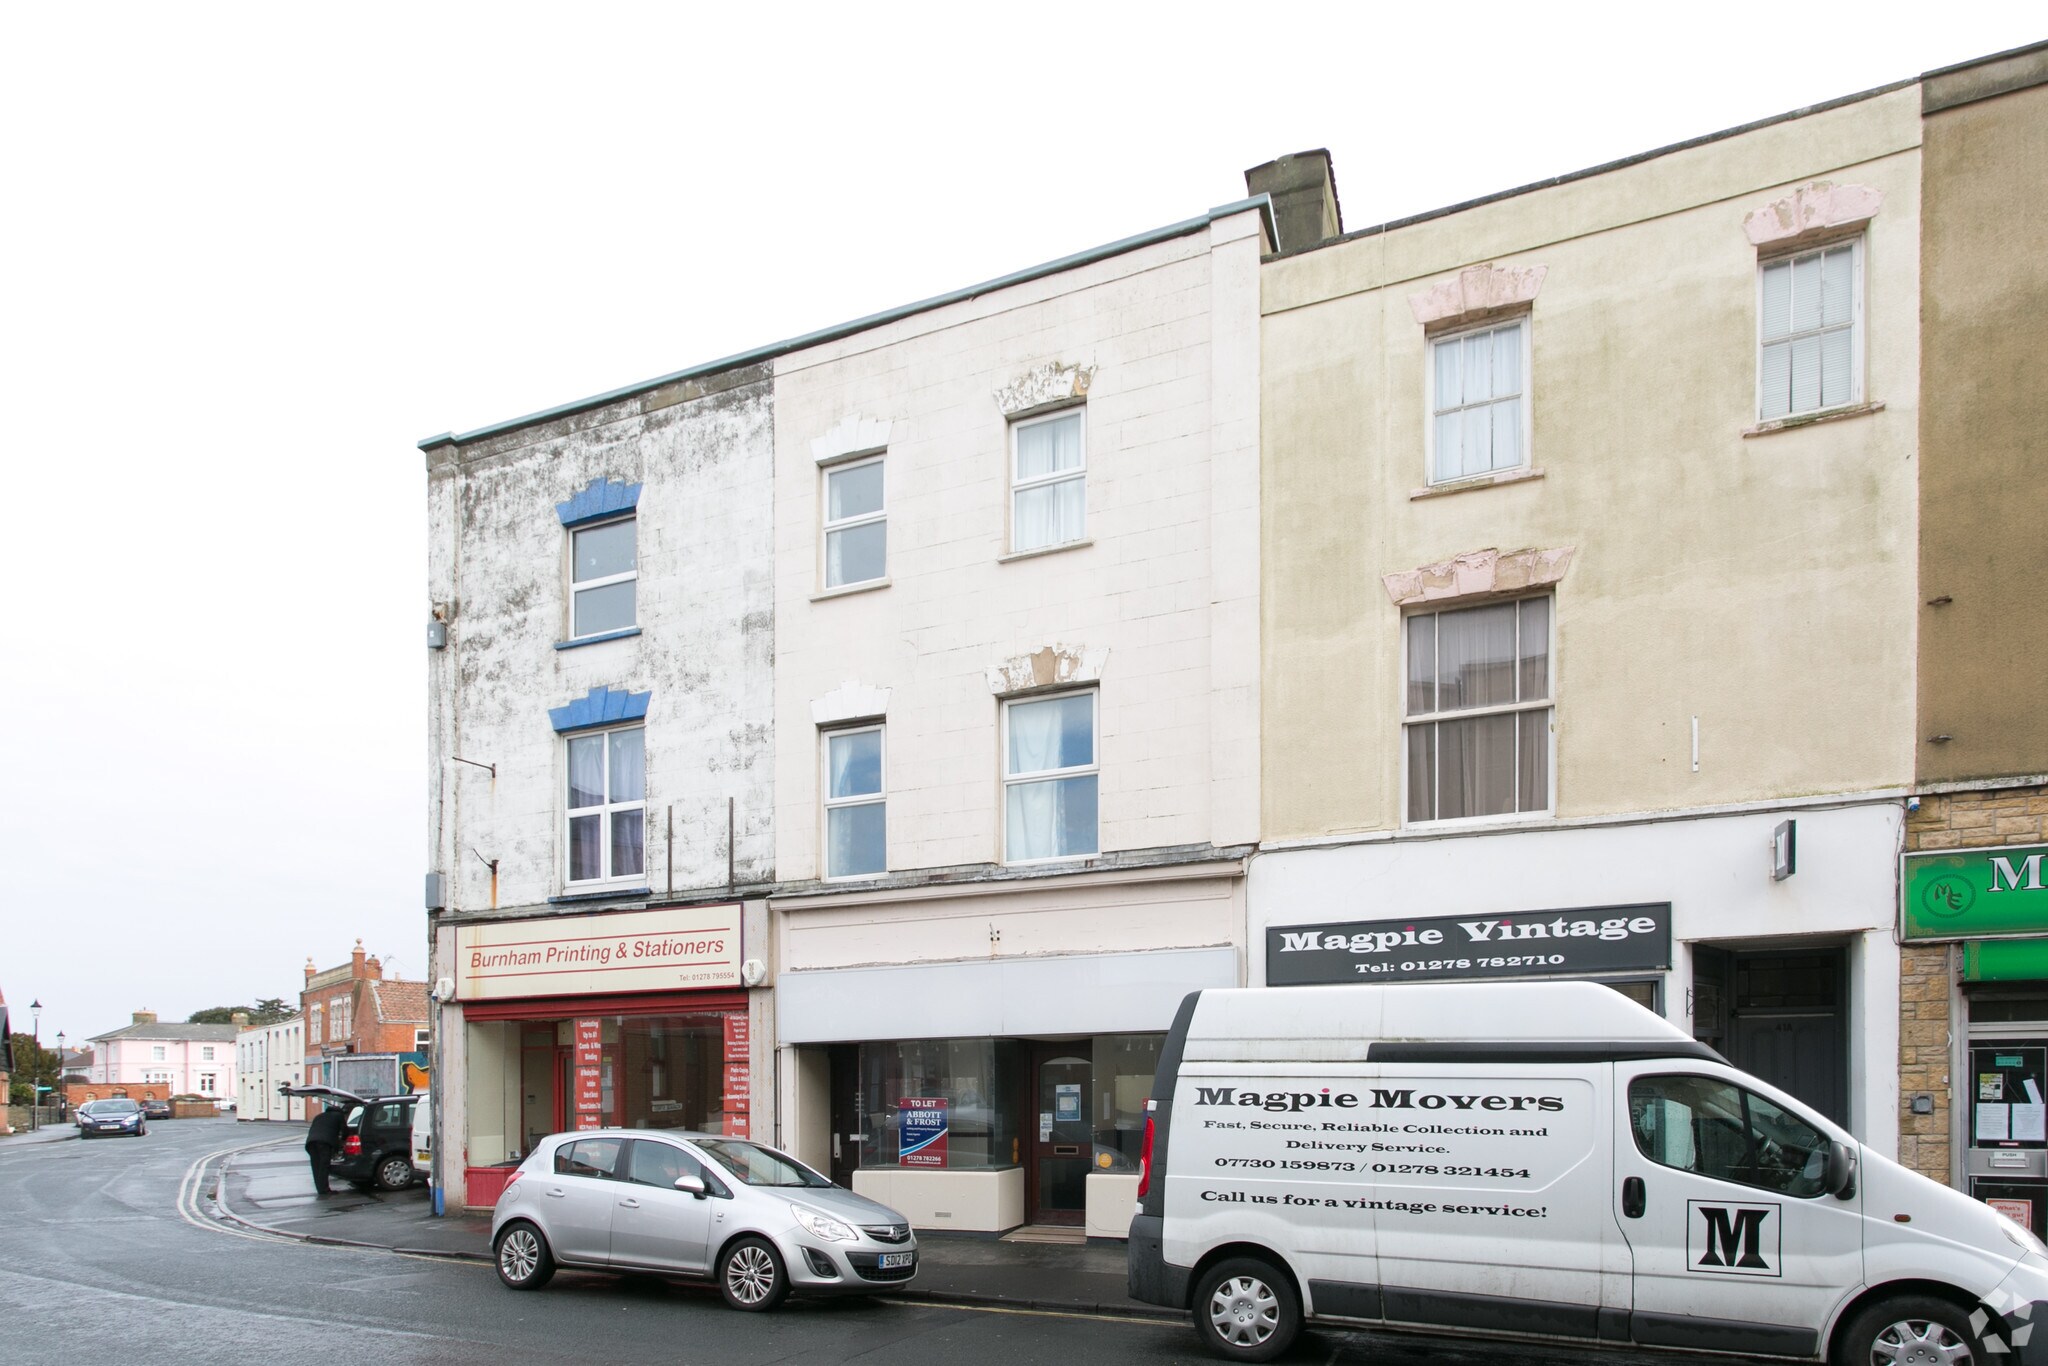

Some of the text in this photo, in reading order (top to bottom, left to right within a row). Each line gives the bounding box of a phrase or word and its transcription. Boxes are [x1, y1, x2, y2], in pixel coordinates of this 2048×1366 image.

[1280, 916, 1656, 954] Magpie Vintage
[471, 939, 724, 968] Burnham Printing & Stationers
[1355, 954, 1565, 973] Tel: 01278 782710
[692, 973, 711, 981] 01278
[712, 972, 735, 980] 795554
[1194, 1087, 1564, 1112] Magpie Movers
[906, 1110, 942, 1118] ABBOTT
[1203, 1120, 1549, 1136] Fast, Secure, Reliable Collection and
[1286, 1140, 1451, 1154] Delivery Service.
[1215, 1158, 1531, 1178] 07730 159873 / 01278 321454
[1200, 1191, 1548, 1218] Call us for a vintage service!
[1698, 1207, 1771, 1269] M
